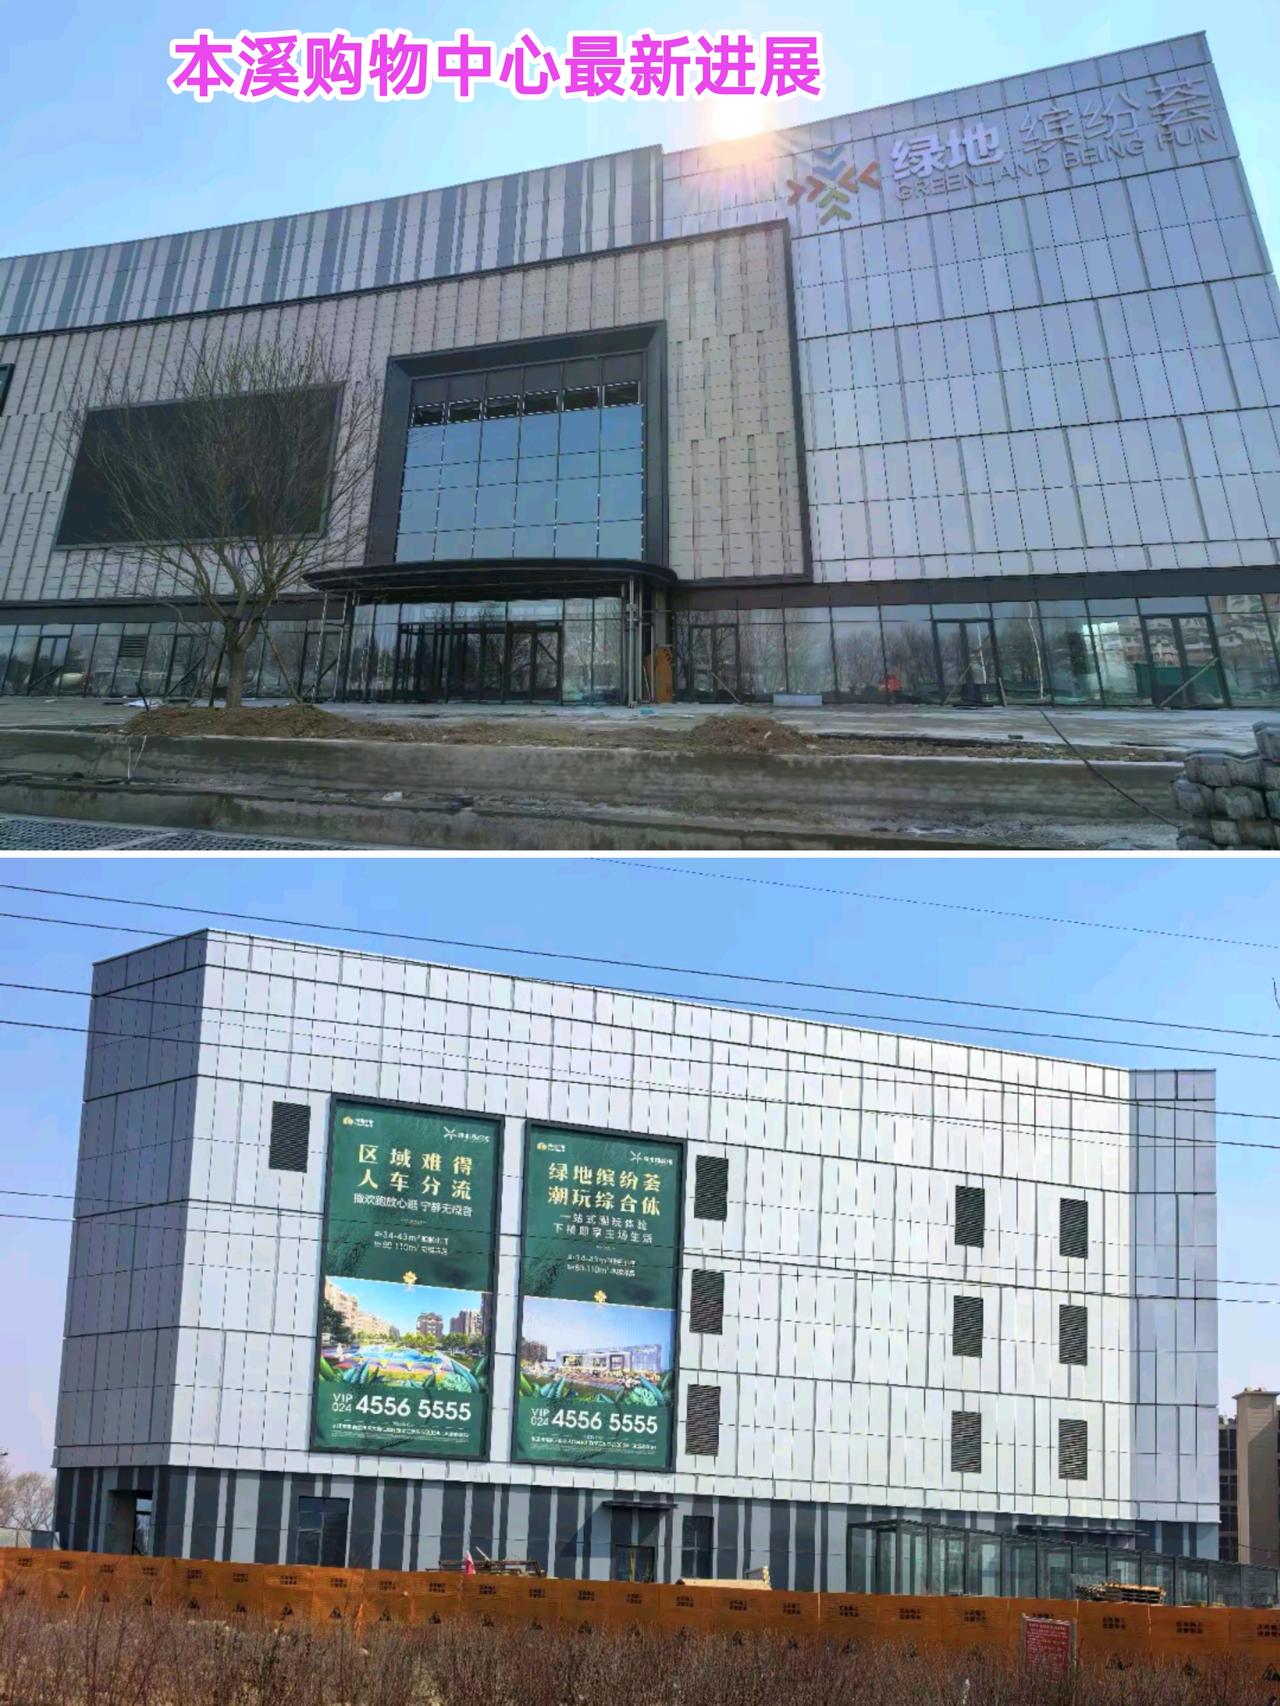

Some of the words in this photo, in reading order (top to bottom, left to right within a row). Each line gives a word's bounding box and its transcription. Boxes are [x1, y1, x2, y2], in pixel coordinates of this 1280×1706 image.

[890, 122, 1000, 181] 绿地
[1020, 79, 1212, 154] 缤纷荟
[895, 156, 1053, 201] GREENLAND
[1063, 138, 1145, 170] BEING
[1158, 123, 1218, 152] FUN
[358, 1144, 473, 1176] 区域难得
[357, 1169, 472, 1201] 人车分流
[548, 1162, 661, 1192] 绿地缤纷荟
[547, 1186, 661, 1216] 潮玩综合体
[331, 1402, 352, 1413] 024
[355, 1394, 411, 1417] 4556
[417, 1399, 472, 1421] 5555
[332, 1392, 353, 1403] VIP
[530, 1417, 549, 1427] 024
[552, 1408, 602, 1430] 4556
[609, 1413, 658, 1434] 5555
[531, 1408, 550, 1418] VIP
